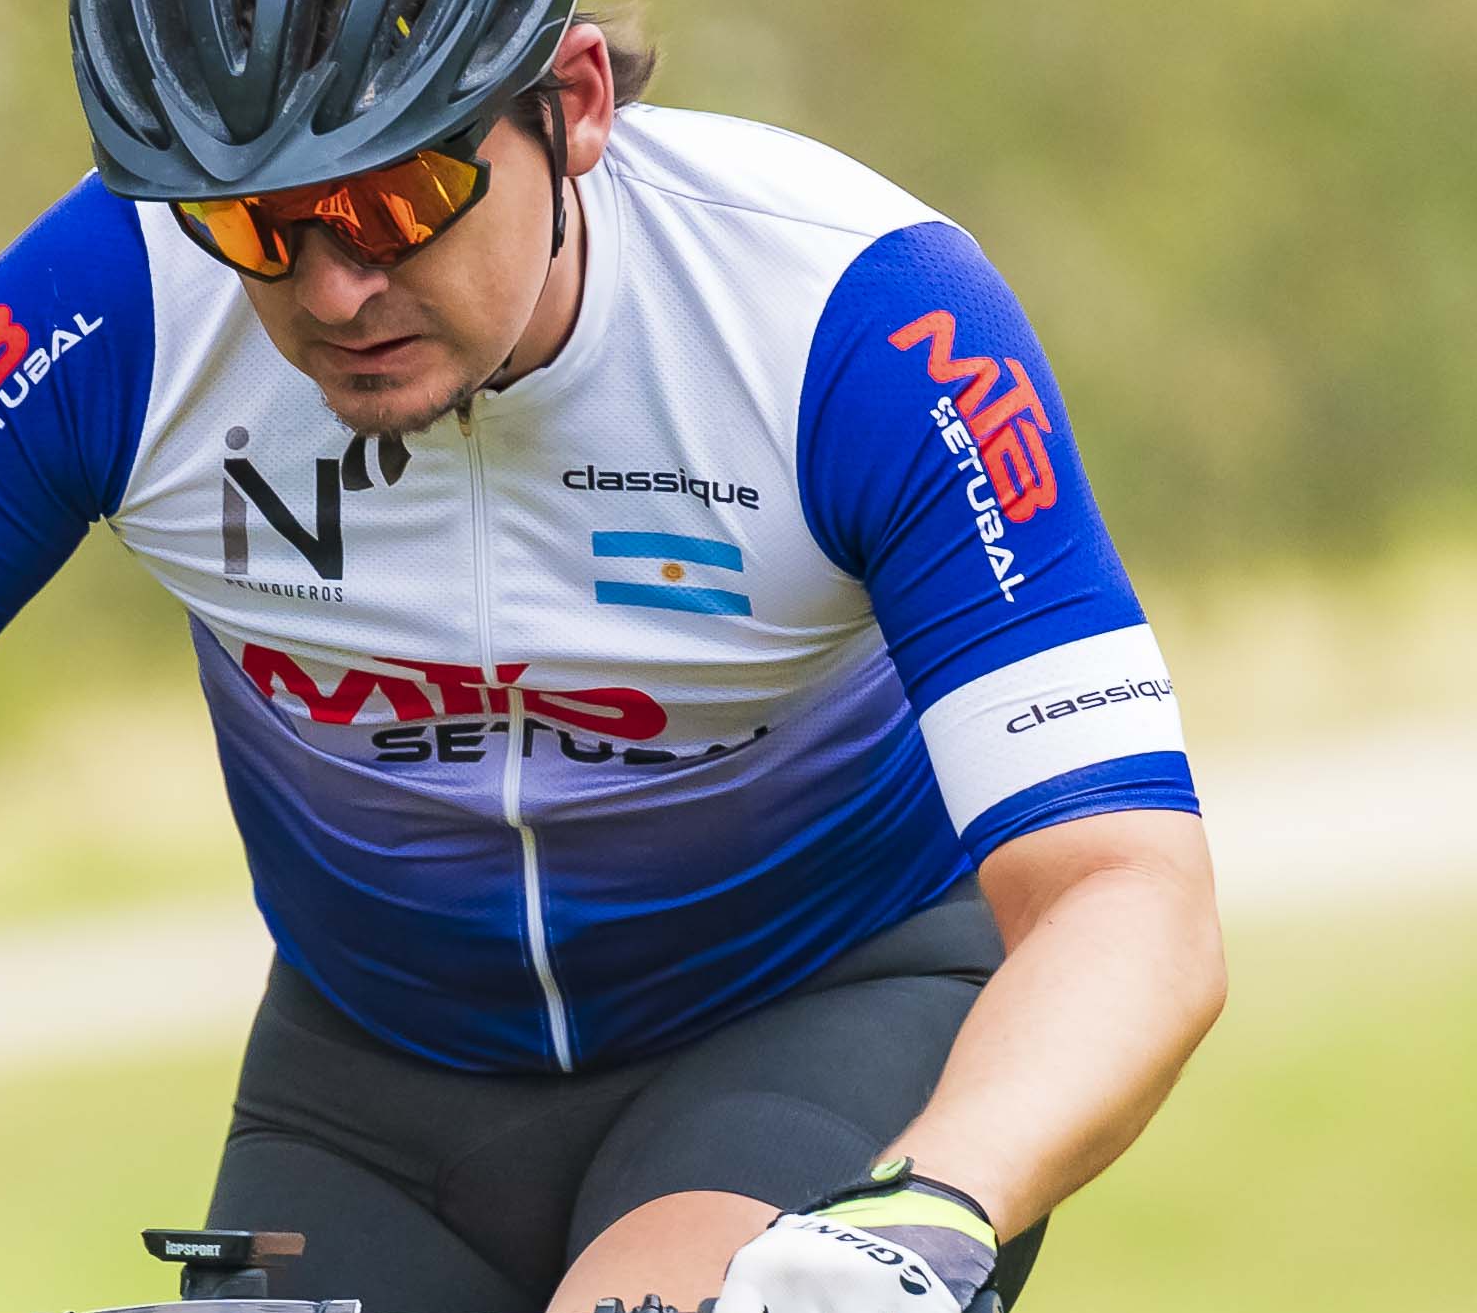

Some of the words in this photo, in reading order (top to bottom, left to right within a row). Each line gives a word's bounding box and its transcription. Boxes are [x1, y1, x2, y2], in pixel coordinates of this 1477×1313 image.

[887, 309, 1058, 523] MTB
[561, 464, 760, 511] classique
[929, 395, 1026, 604] SETUBAL
[1006, 678, 1174, 734] classiqu
